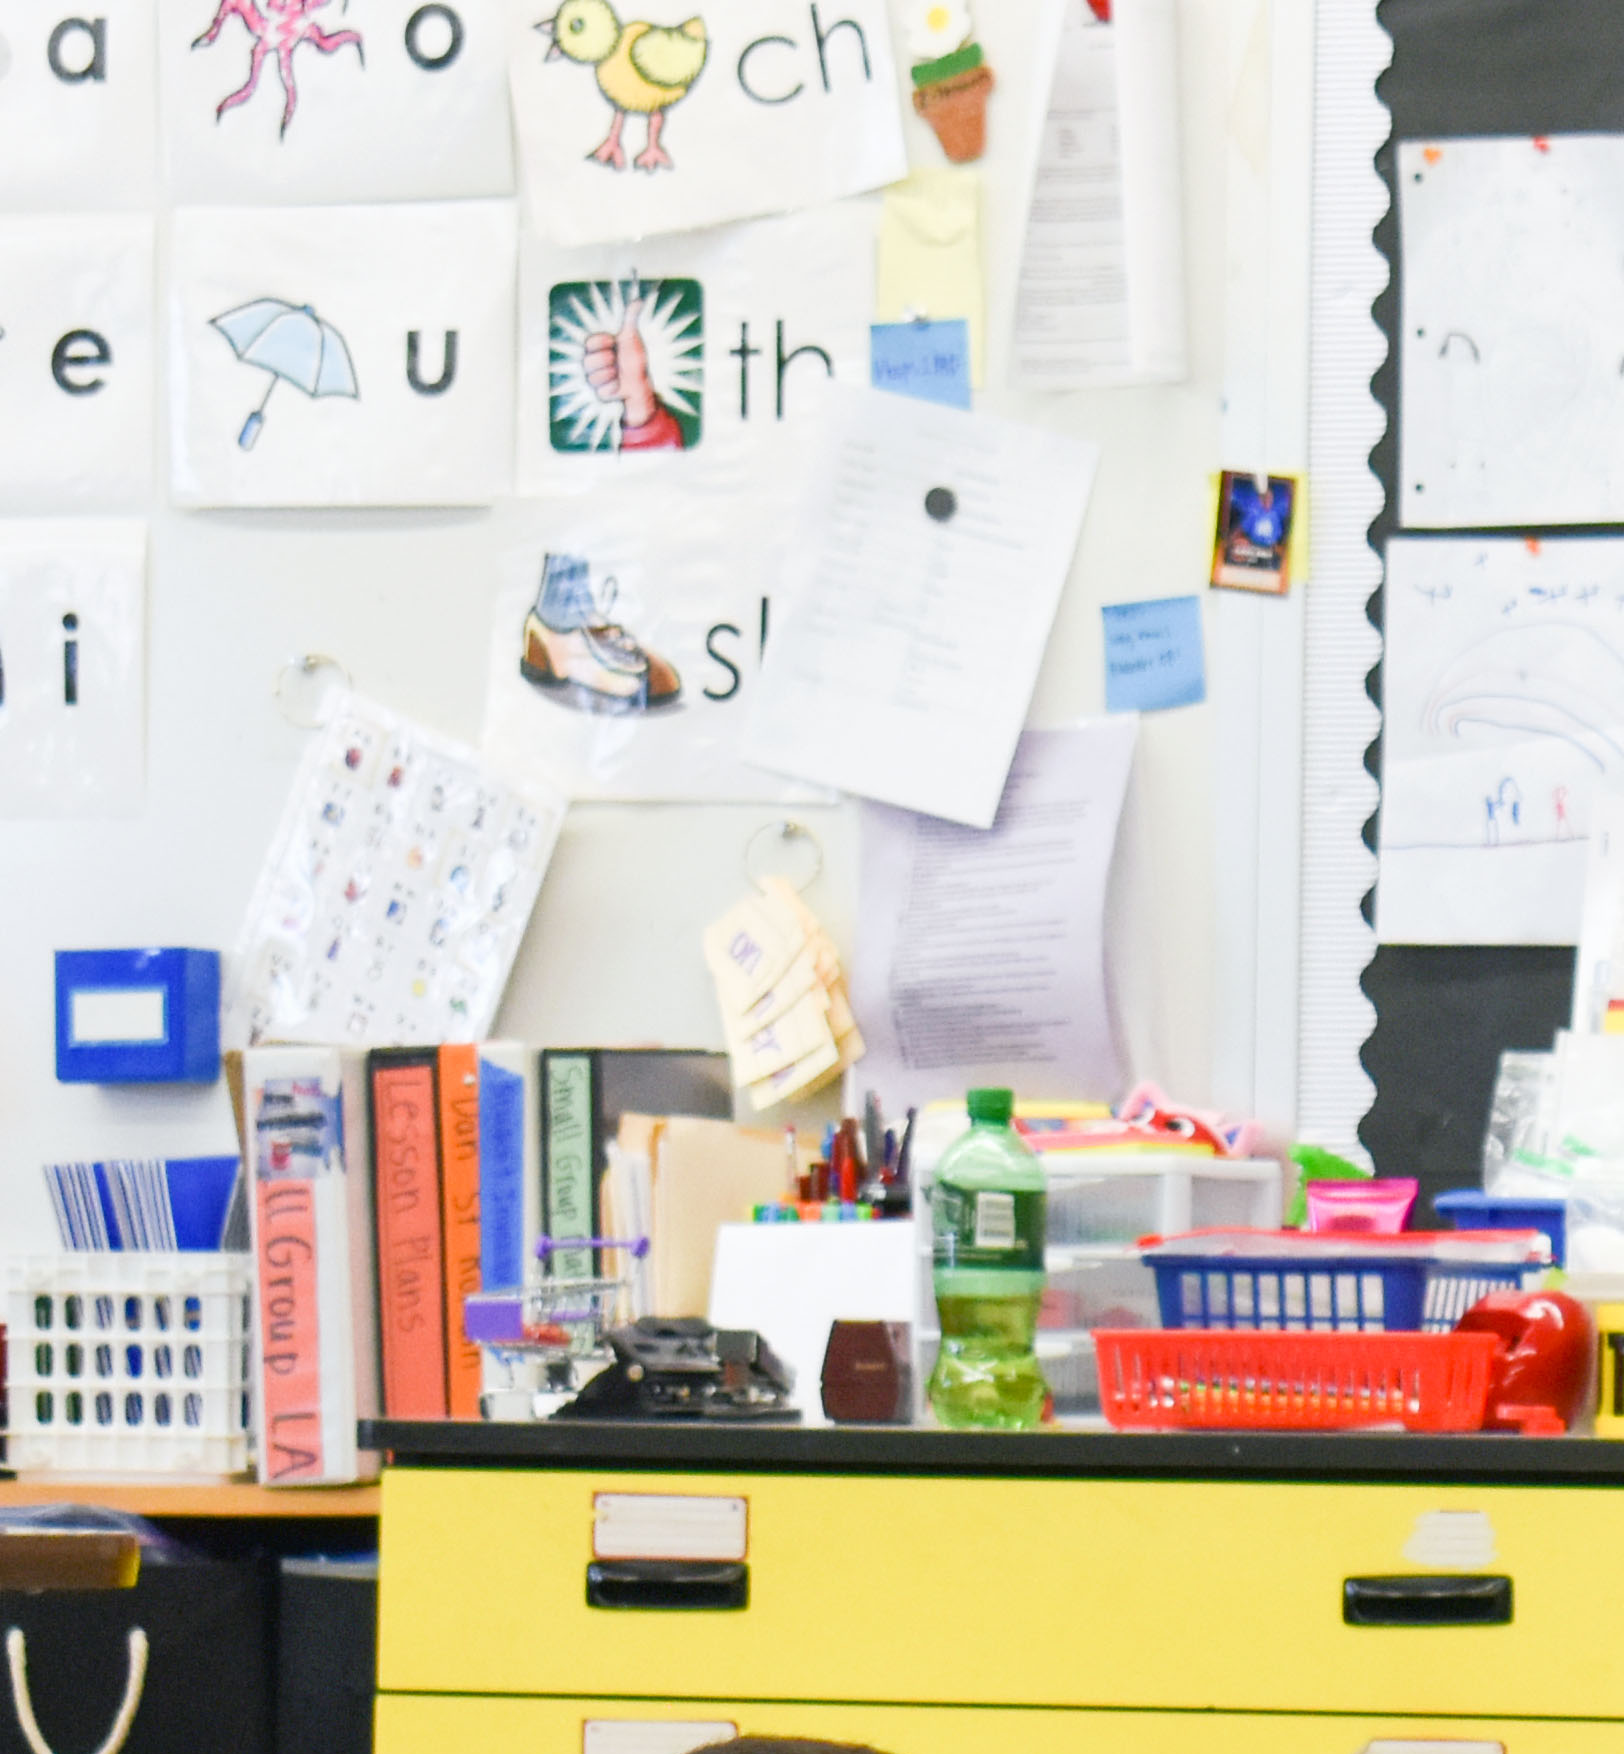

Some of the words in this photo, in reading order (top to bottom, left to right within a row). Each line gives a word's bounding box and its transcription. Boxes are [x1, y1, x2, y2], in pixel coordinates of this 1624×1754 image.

[47, 15, 109, 84] a
[403, 3, 465, 72] o
[736, 8, 873, 105] ch
[50, 326, 113, 396] e
[405, 328, 460, 397] u
[729, 319, 835, 422] th
[61, 611, 80, 707] i
[702, 595, 772, 703] s
[385, 1079, 426, 1214] Lesson
[549, 1064, 593, 1146] Small
[262, 1234, 313, 1379] Group
[390, 1232, 432, 1335] Plans
